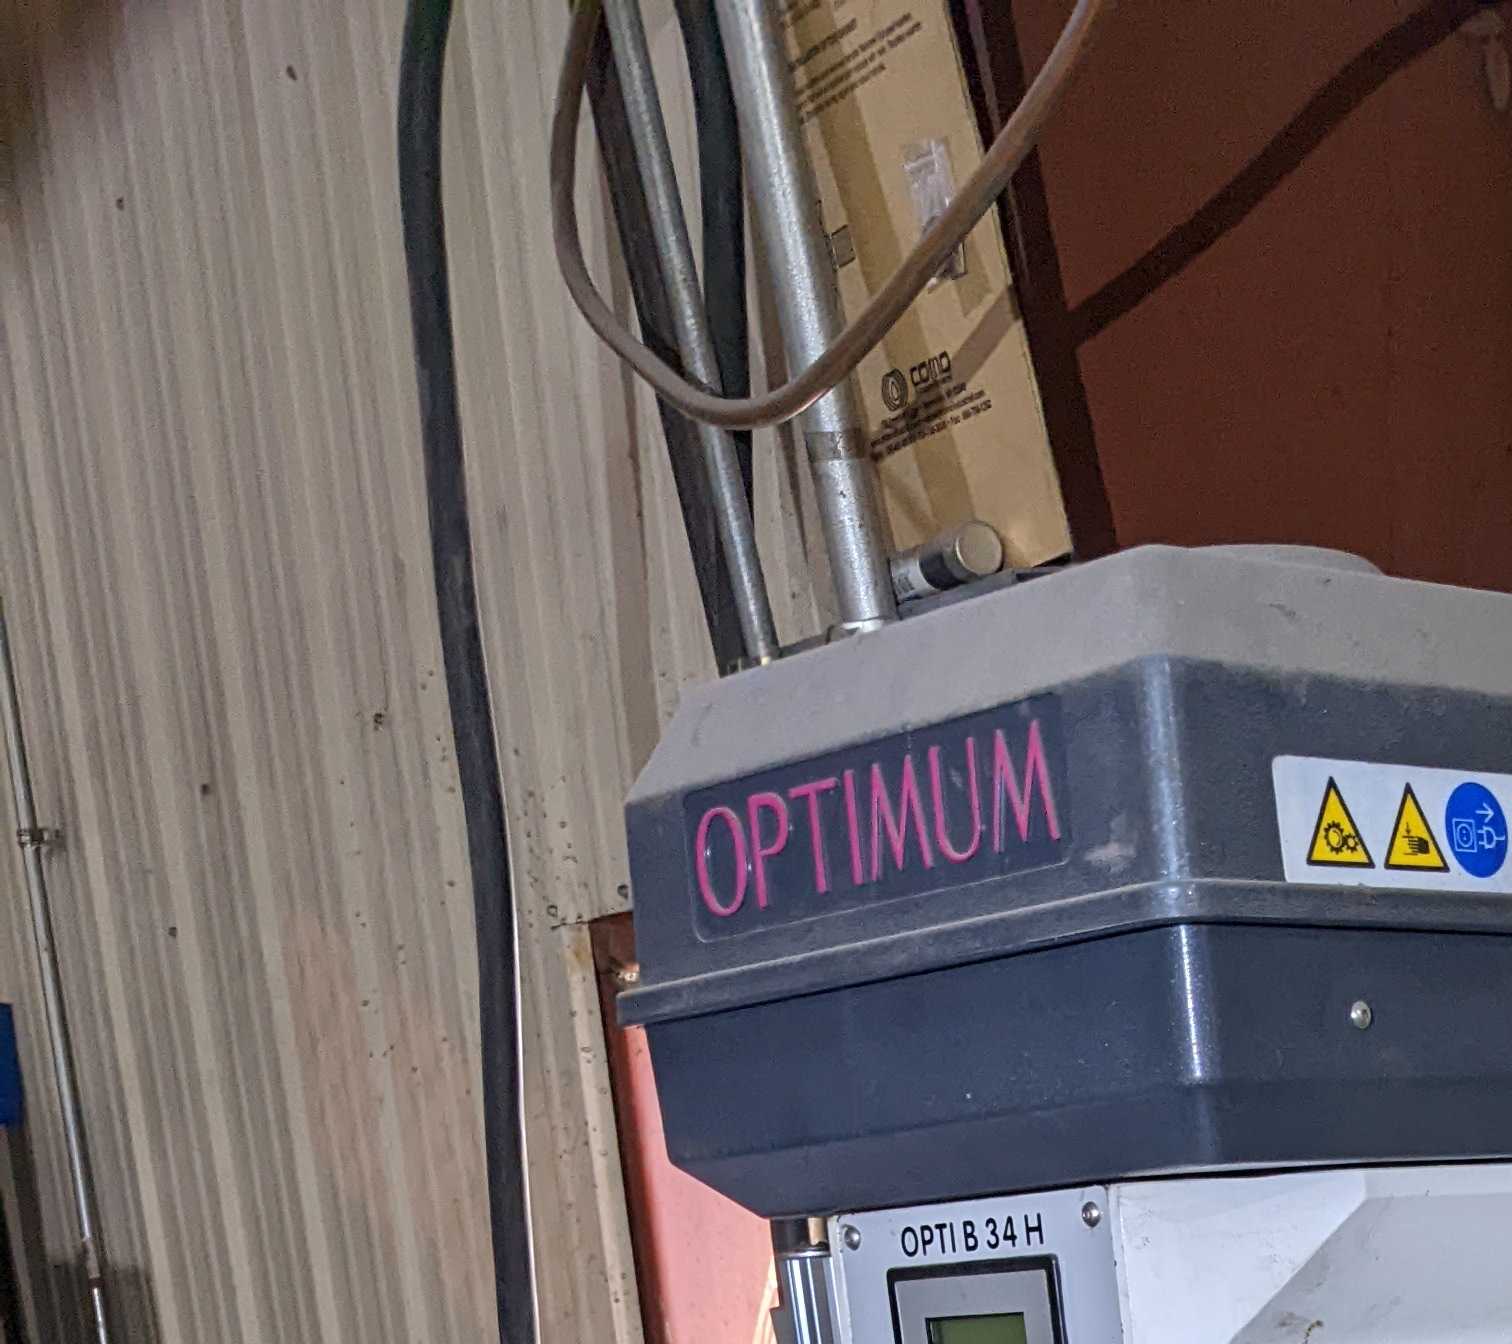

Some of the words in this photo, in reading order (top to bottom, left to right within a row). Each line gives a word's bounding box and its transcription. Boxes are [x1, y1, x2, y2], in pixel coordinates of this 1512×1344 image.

[696, 719, 1062, 917] OPTIMUM
[901, 1222, 957, 1257] OPTI
[963, 1220, 979, 1251] B
[985, 1216, 1018, 1249] 34
[1024, 1213, 1044, 1246] H
